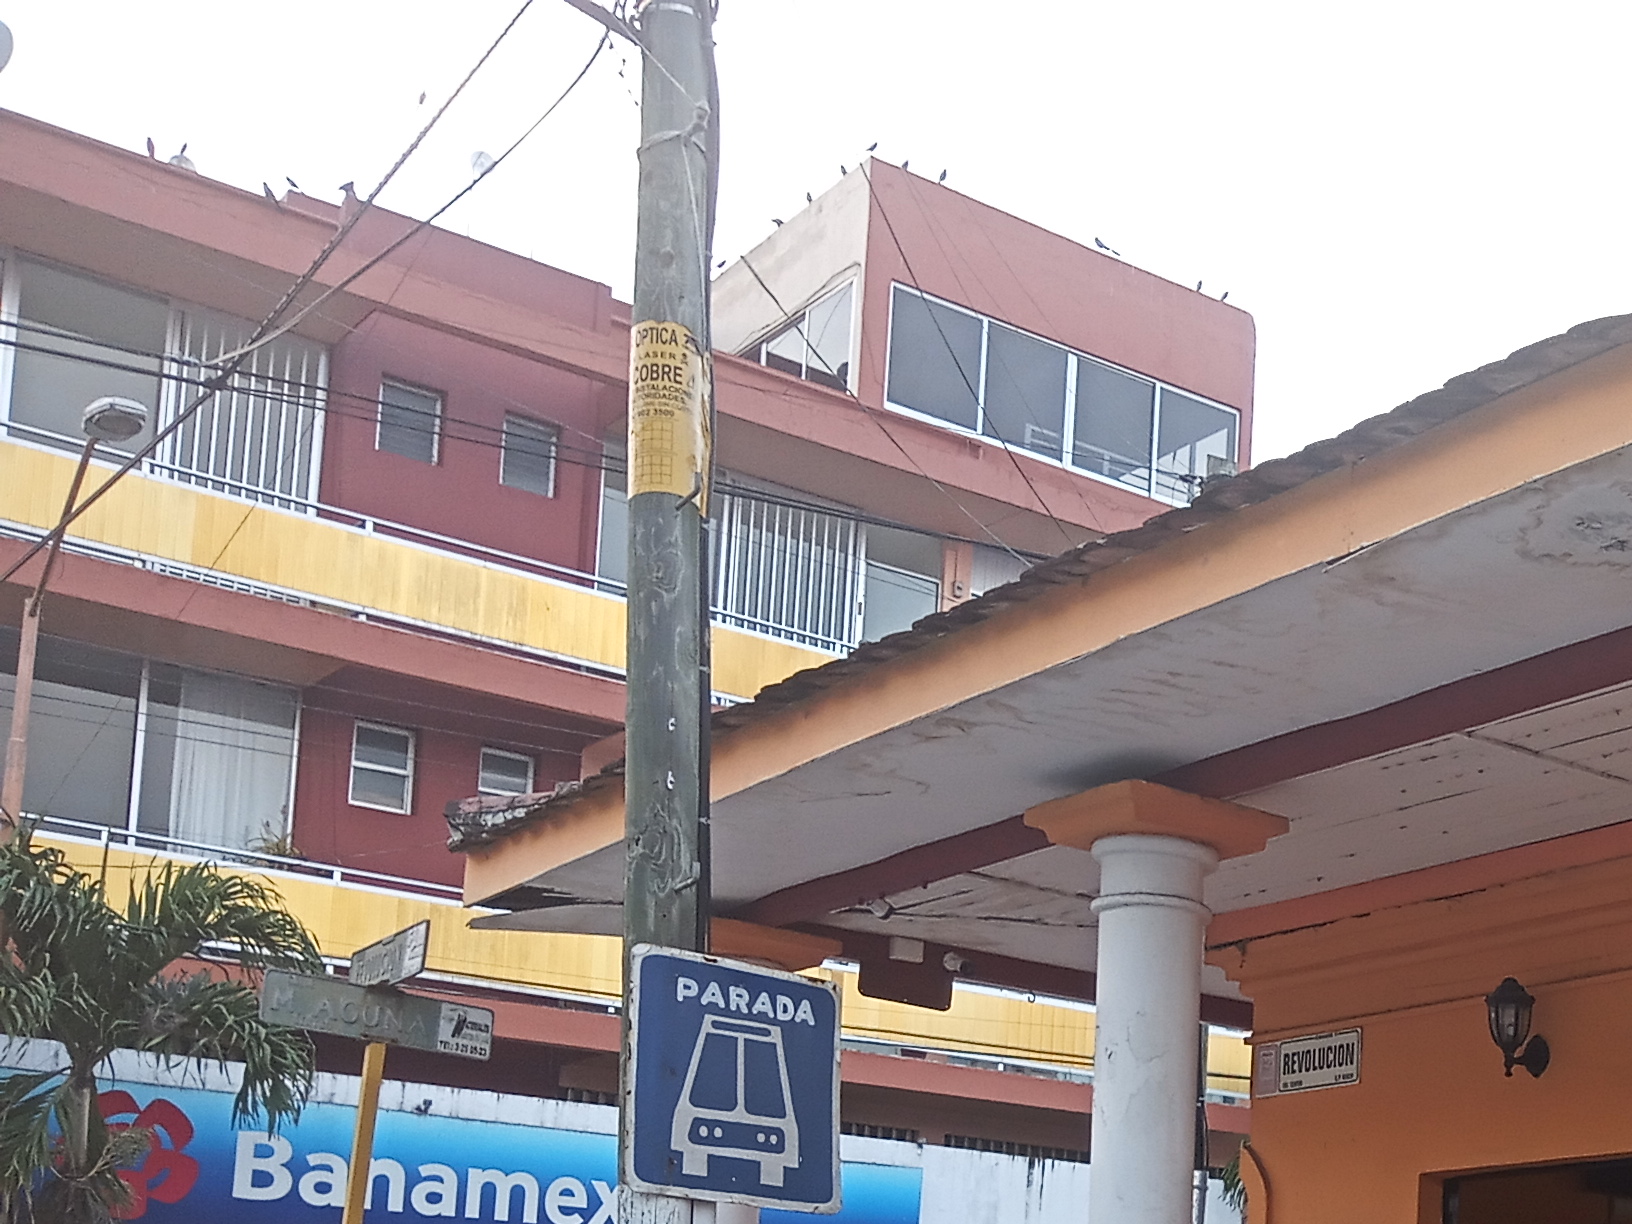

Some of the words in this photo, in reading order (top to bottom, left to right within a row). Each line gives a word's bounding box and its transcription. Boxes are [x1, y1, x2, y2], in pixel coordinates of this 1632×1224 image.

[636, 327, 678, 347] OPTICA
[676, 976, 815, 1026] PARADA
[1282, 1042, 1355, 1076] REVOLUCION
